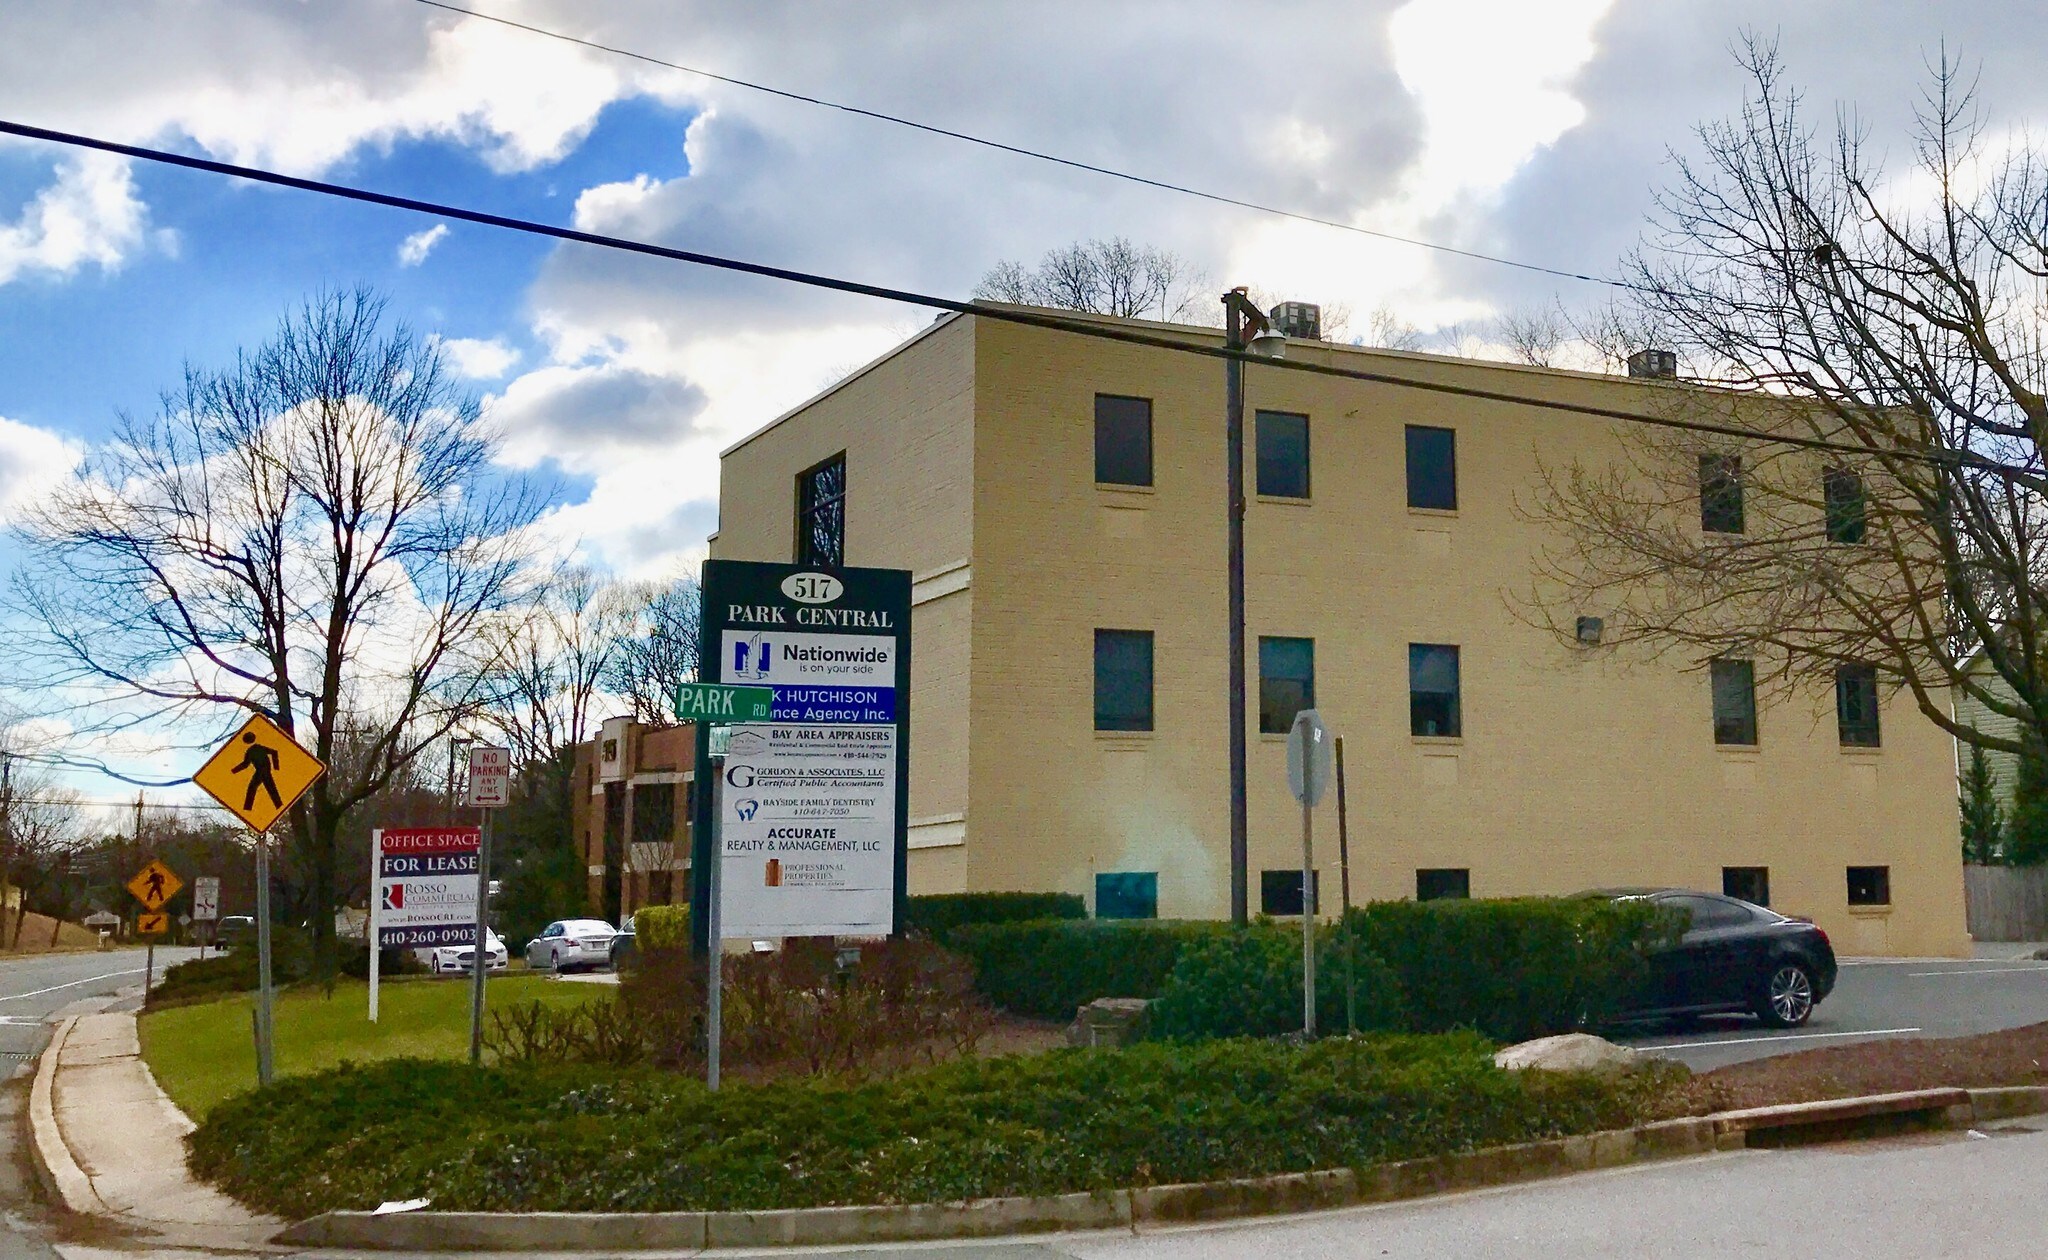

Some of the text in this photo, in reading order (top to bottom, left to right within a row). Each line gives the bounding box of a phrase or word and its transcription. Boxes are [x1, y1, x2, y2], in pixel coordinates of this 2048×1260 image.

[794, 578, 832, 599] 517
[727, 604, 894, 628] PARK CENTRAL
[783, 644, 888, 663] Nationwide
[799, 663, 874, 675] is on your side
[679, 687, 767, 717] PARK RD
[787, 690, 877, 703] HUTCHISON
[769, 706, 890, 721] nce Agency Inc.
[772, 729, 890, 741] BAY AREA APPRAISERS
[482, 752, 498, 764] NO
[472, 766, 507, 776] PARKING
[727, 765, 756, 789] G
[757, 768, 885, 777] GORDON & ASSOCIATES, LLC
[481, 778, 497, 786] ANY
[757, 779, 885, 789] Certified Public Accountants
[480, 786, 498, 794] TIME
[763, 799, 876, 807] BAYSIDE FAMILY DENTISTRY
[793, 808, 851, 816] 410-647-7050
[767, 828, 837, 839] ACCURATE
[382, 833, 480, 848] OFFICE SPACE
[727, 840, 881, 852] REALTY & MANAGEMENT, LLC
[384, 856, 478, 873] FOR LEASE
[785, 864, 847, 872] PROFESSIONAL
[785, 872, 834, 880] PROPERTIES
[404, 893, 475, 904] COMMERCIAL
